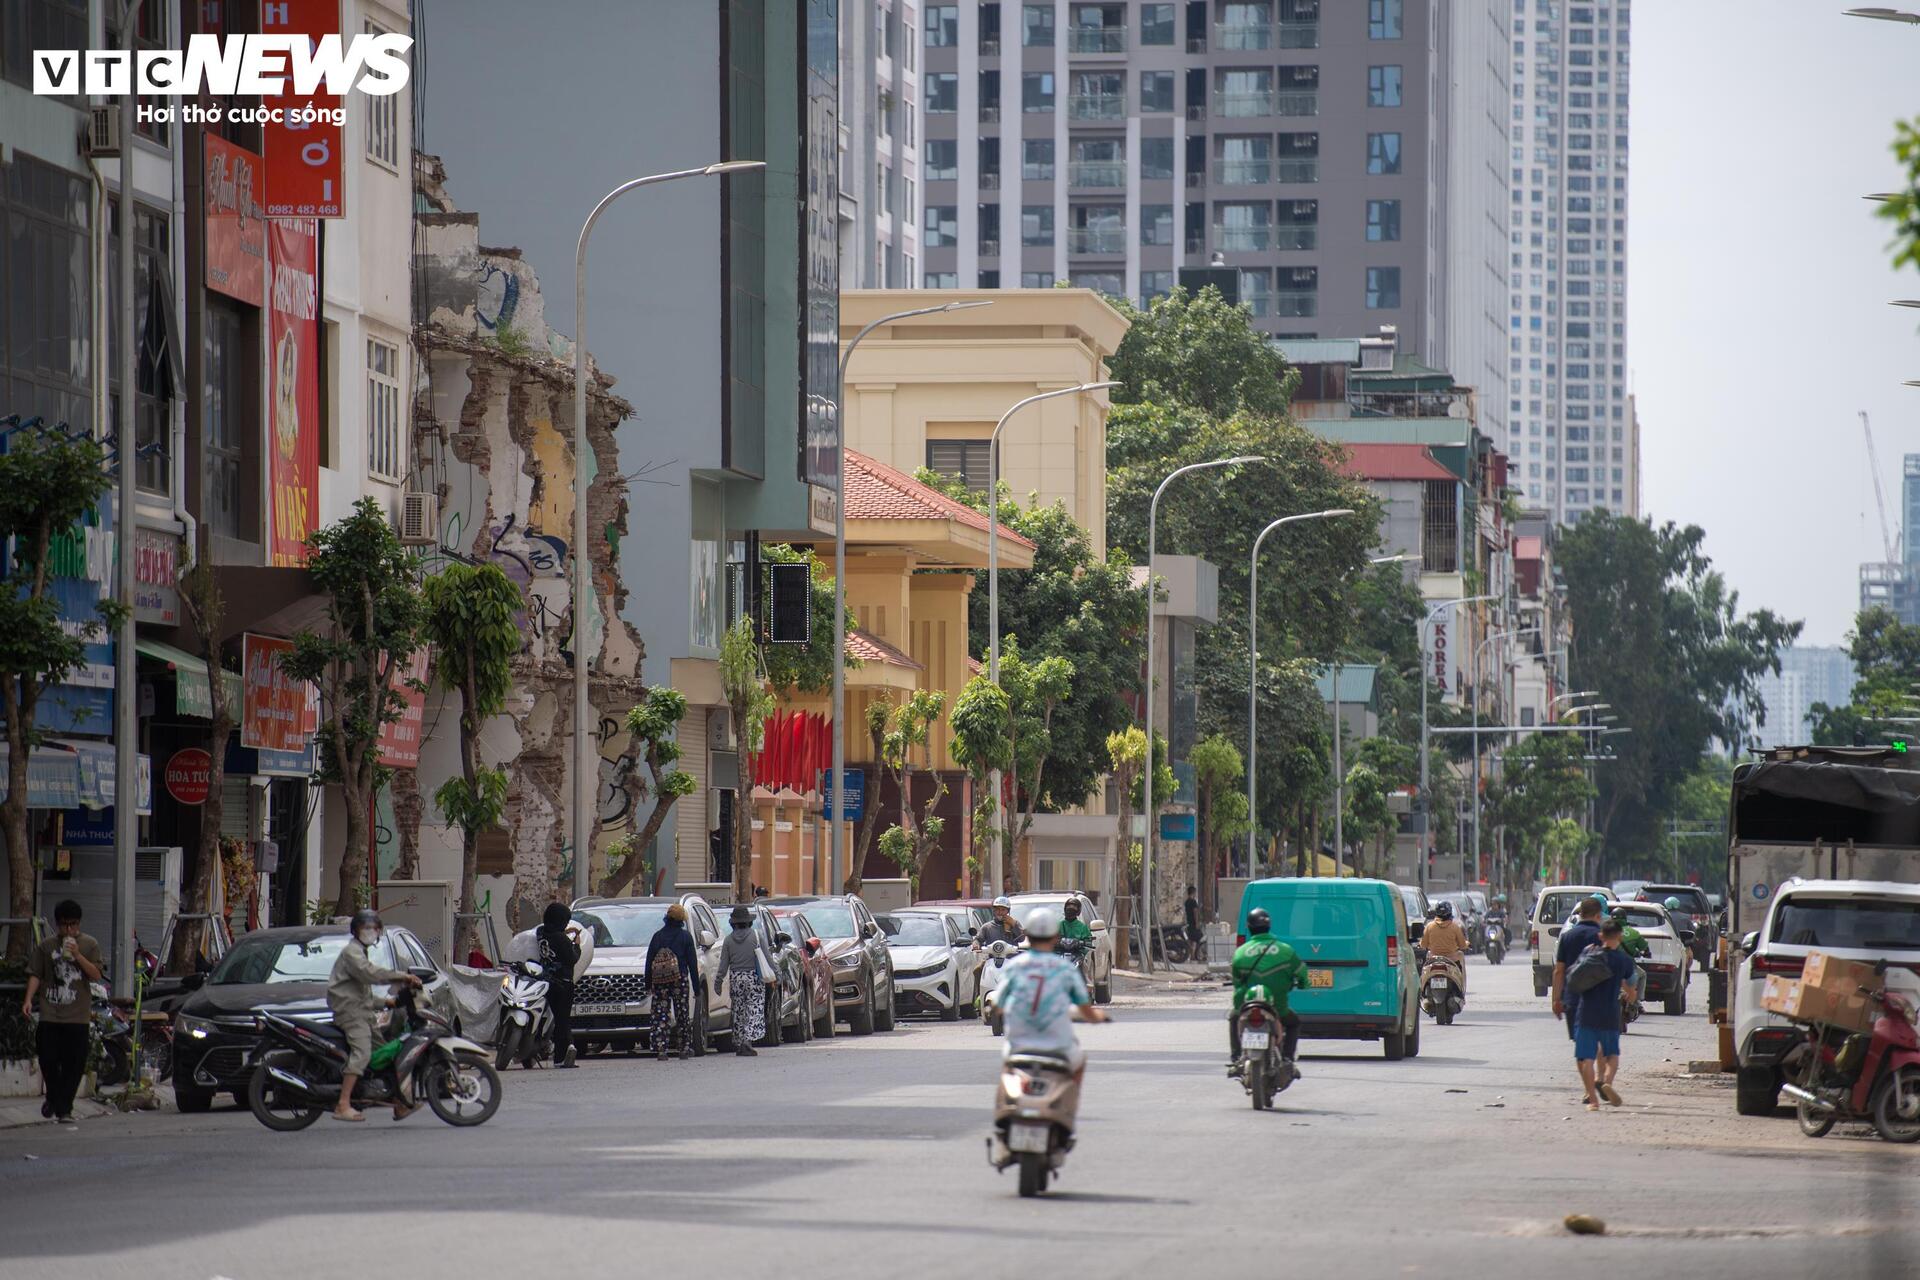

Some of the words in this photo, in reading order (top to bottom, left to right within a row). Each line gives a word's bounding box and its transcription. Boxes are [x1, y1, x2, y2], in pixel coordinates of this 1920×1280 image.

[267, 205, 294, 215] 0982
[296, 205, 315, 215] 482
[317, 205, 338, 215] 468
[1434, 623, 1448, 690] KOREA
[168, 770, 189, 782] HOA
